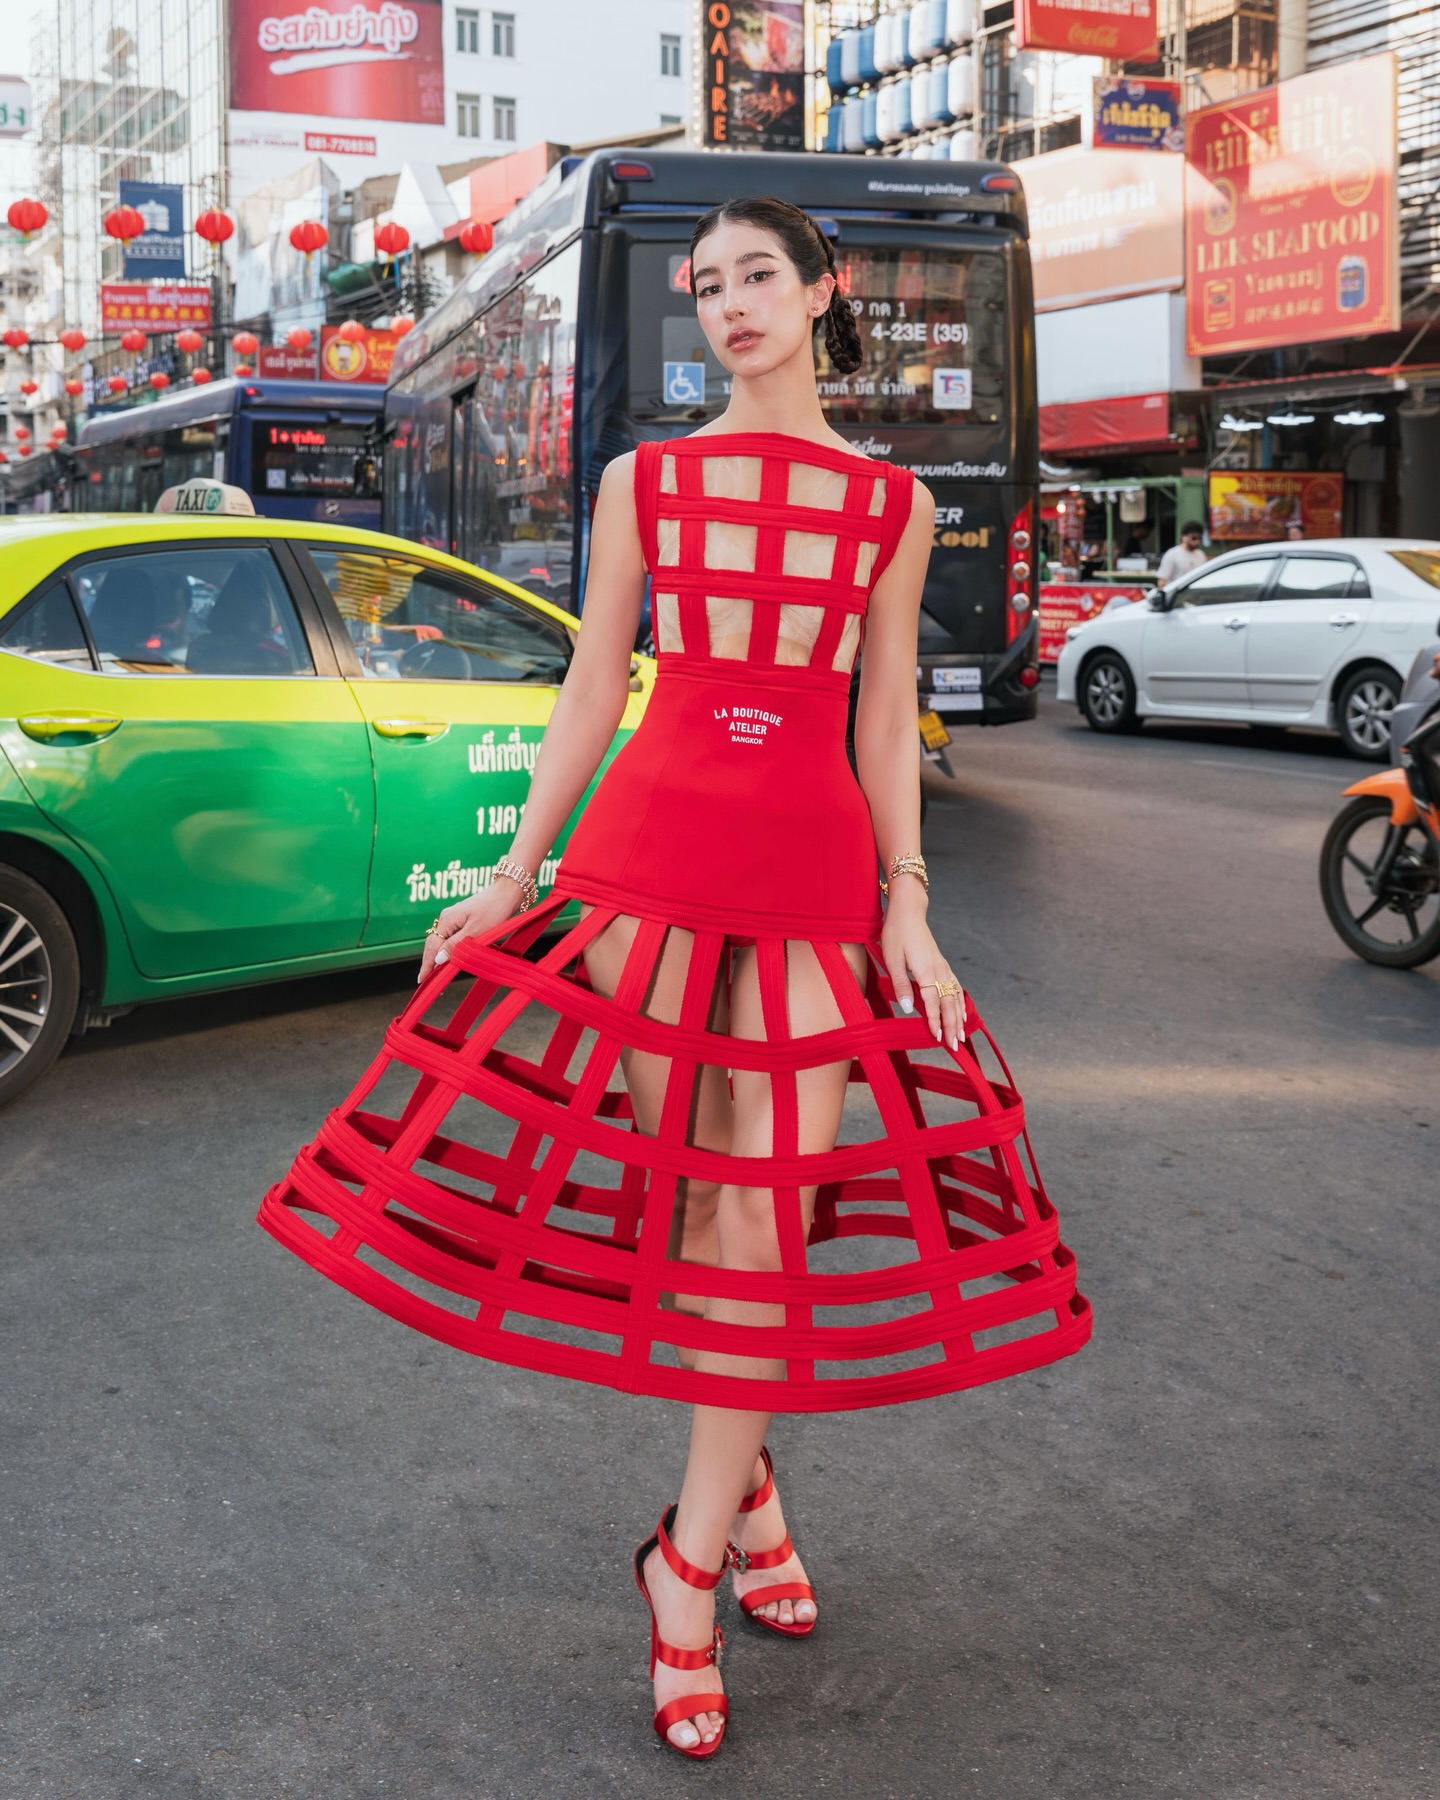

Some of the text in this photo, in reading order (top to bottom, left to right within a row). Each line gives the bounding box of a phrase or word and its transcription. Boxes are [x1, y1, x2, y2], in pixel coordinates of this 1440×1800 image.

[258, 2, 418, 53] รสต้มยำกุ้ง
[1197, 234, 1249, 273] LEK
[1252, 211, 1380, 263] SEAFOOD
[869, 302, 891, 317] กด
[898, 301, 907, 317] 1
[870, 323, 969, 344] 4-23E (35)
[855, 376, 875, 395] บัส
[176, 489, 208, 511] TAXI
[714, 707, 783, 726] LA BOUTIQUE
[728, 721, 767, 735] ATELIER
[731, 735, 763, 745] BANGKOK
[476, 806, 486, 835] 1
